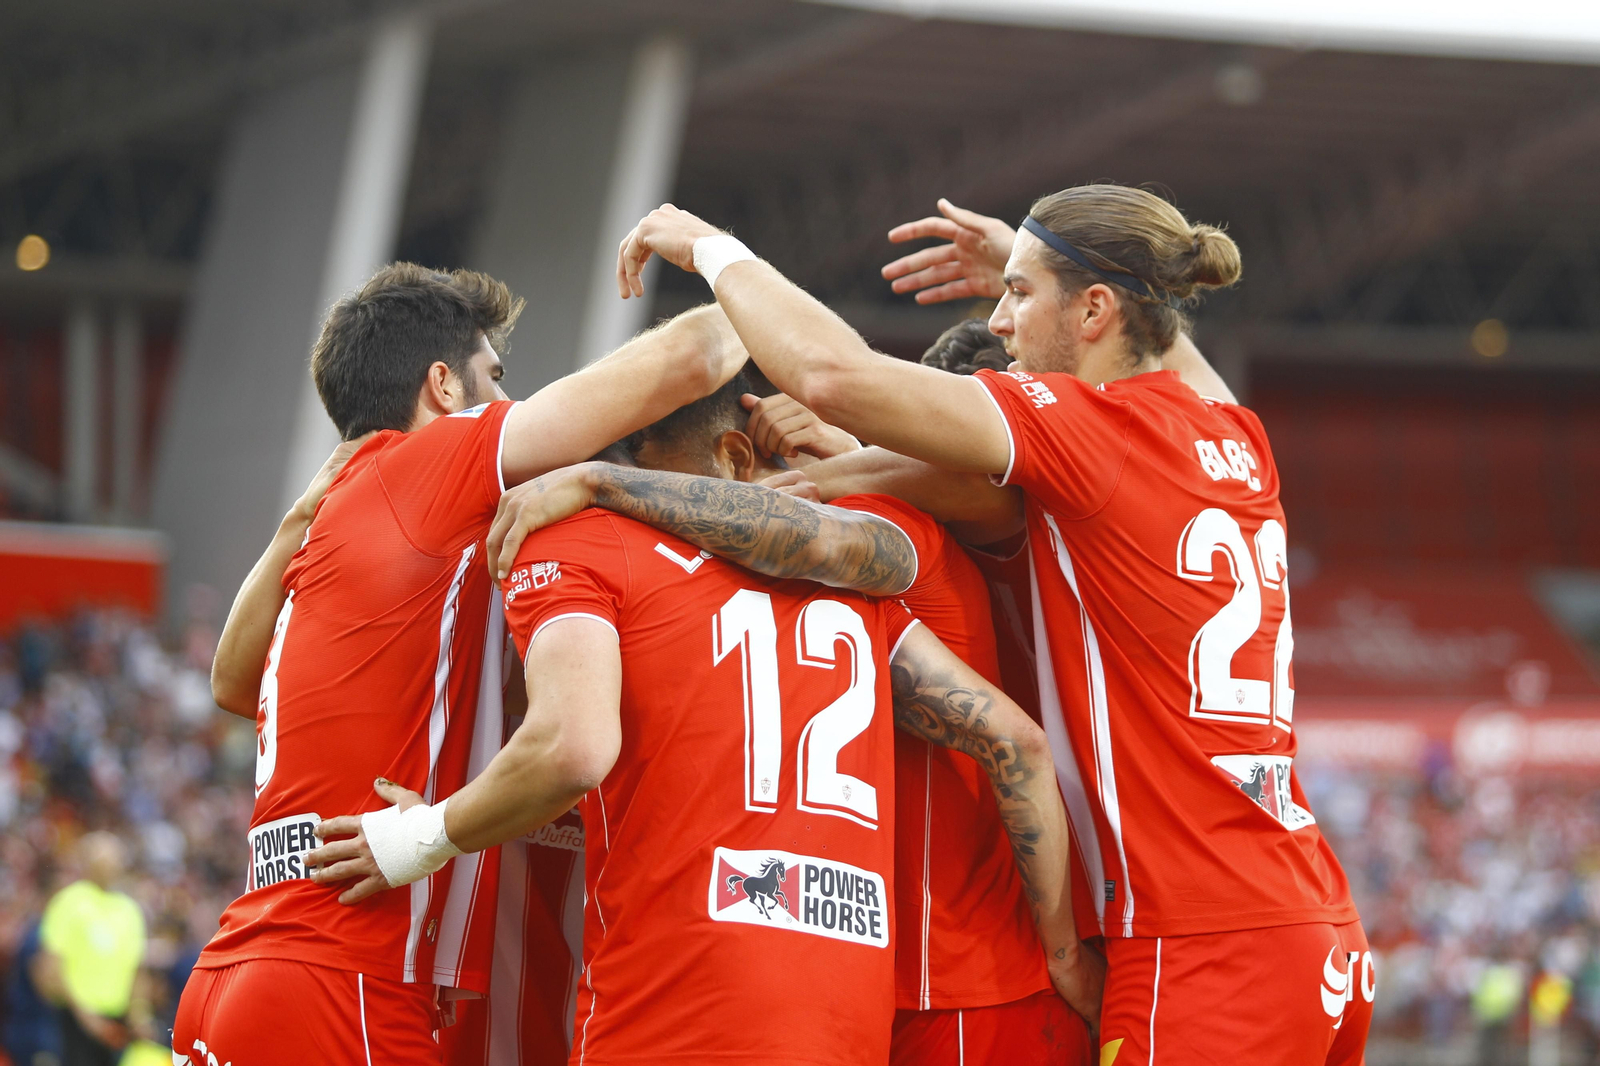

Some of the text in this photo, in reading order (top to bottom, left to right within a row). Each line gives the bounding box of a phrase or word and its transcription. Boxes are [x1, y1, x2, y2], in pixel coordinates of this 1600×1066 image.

[1177, 507, 1295, 733] 22
[712, 588, 879, 831] 12
[254, 821, 317, 863] POWER
[804, 864, 880, 908] POWER
[803, 895, 882, 940] HORSE
